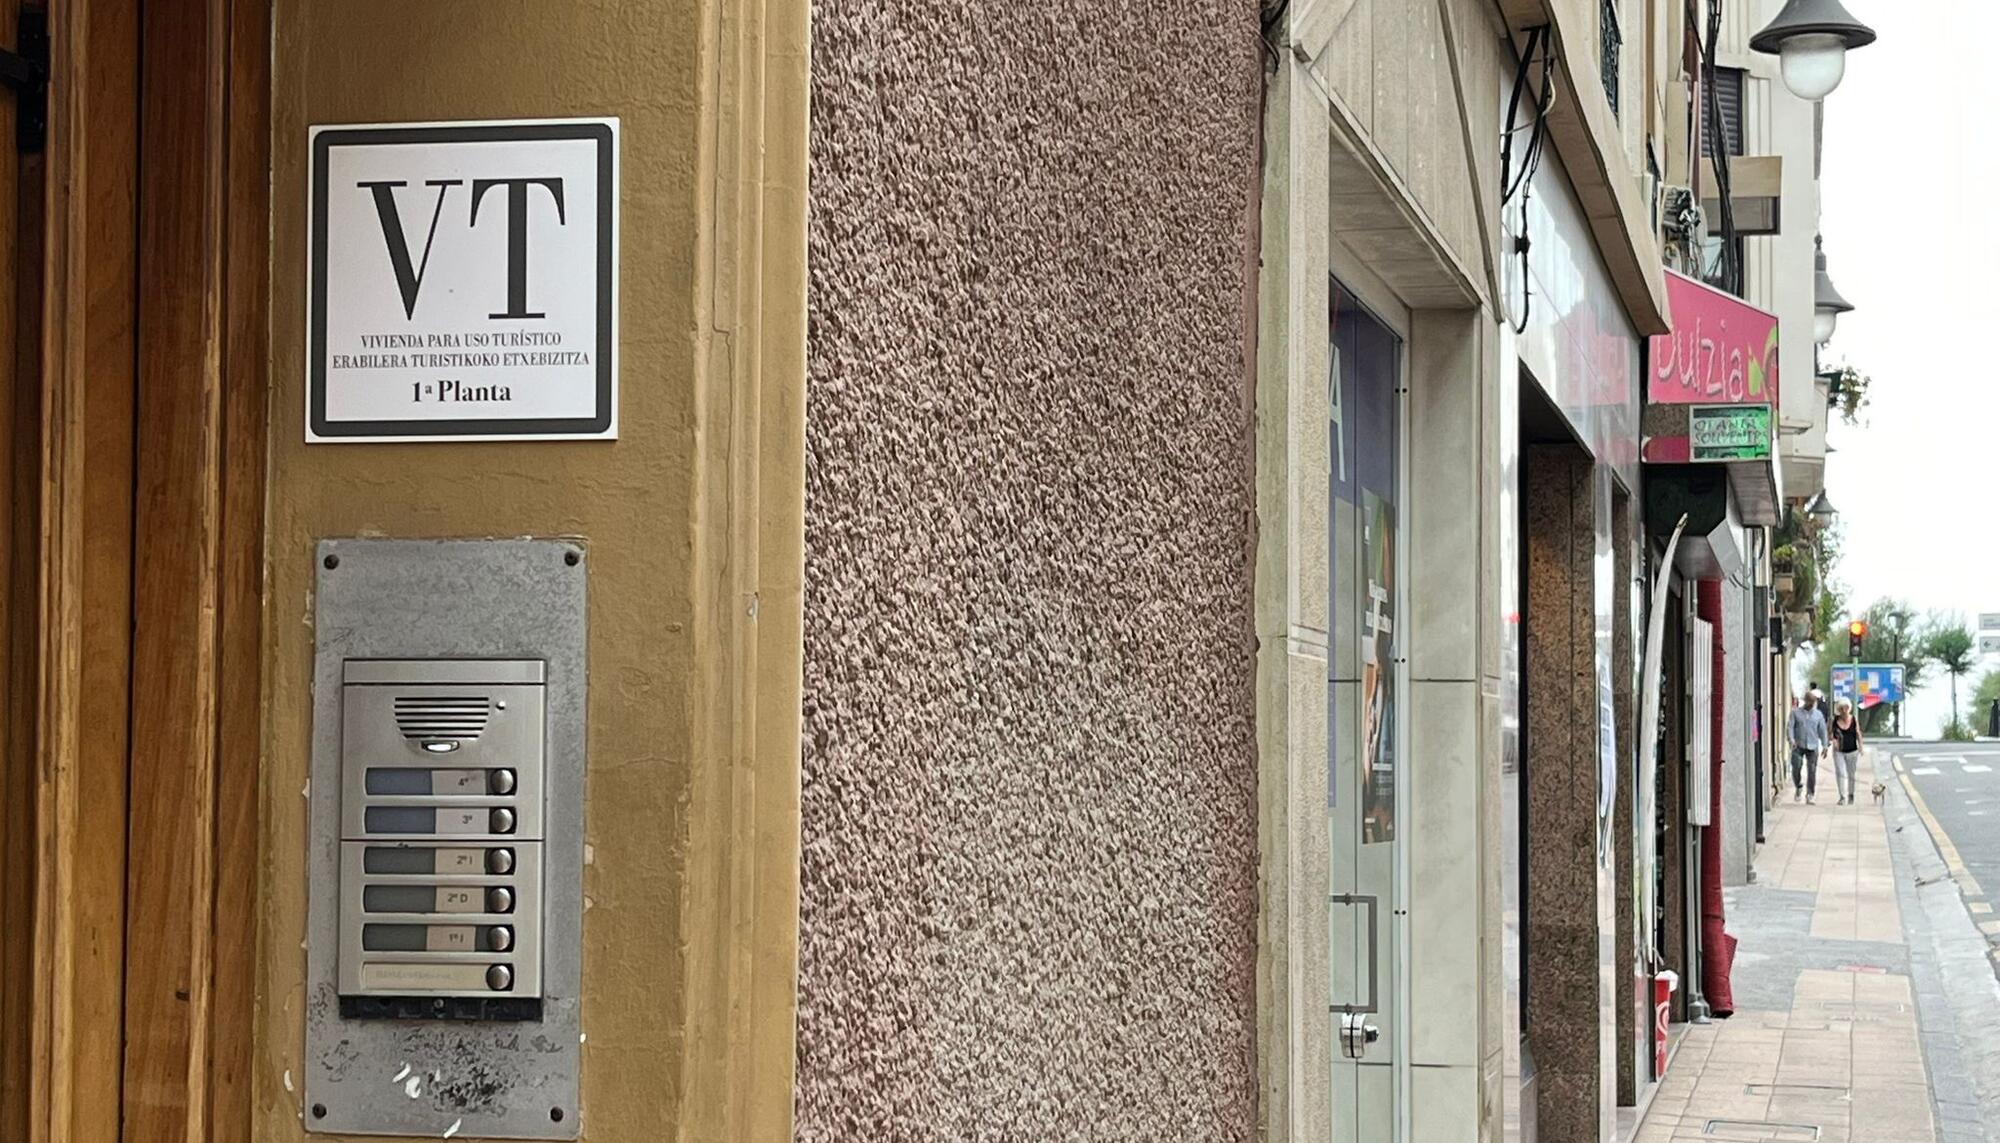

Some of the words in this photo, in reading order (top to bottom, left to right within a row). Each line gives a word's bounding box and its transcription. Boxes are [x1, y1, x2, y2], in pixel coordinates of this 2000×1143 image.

[356, 177, 566, 321] VT
[360, 334, 424, 348] VIVIENDA
[427, 333, 461, 348] PARA
[464, 332, 489, 347] USO
[491, 329, 561, 347] TURÍSTICO
[332, 353, 408, 369] ERABILERA
[410, 352, 500, 368] TURISTIKOKO
[502, 351, 590, 367] ETXEBIZITZA
[412, 381, 432, 402] 1ª
[437, 379, 512, 402] Planta
